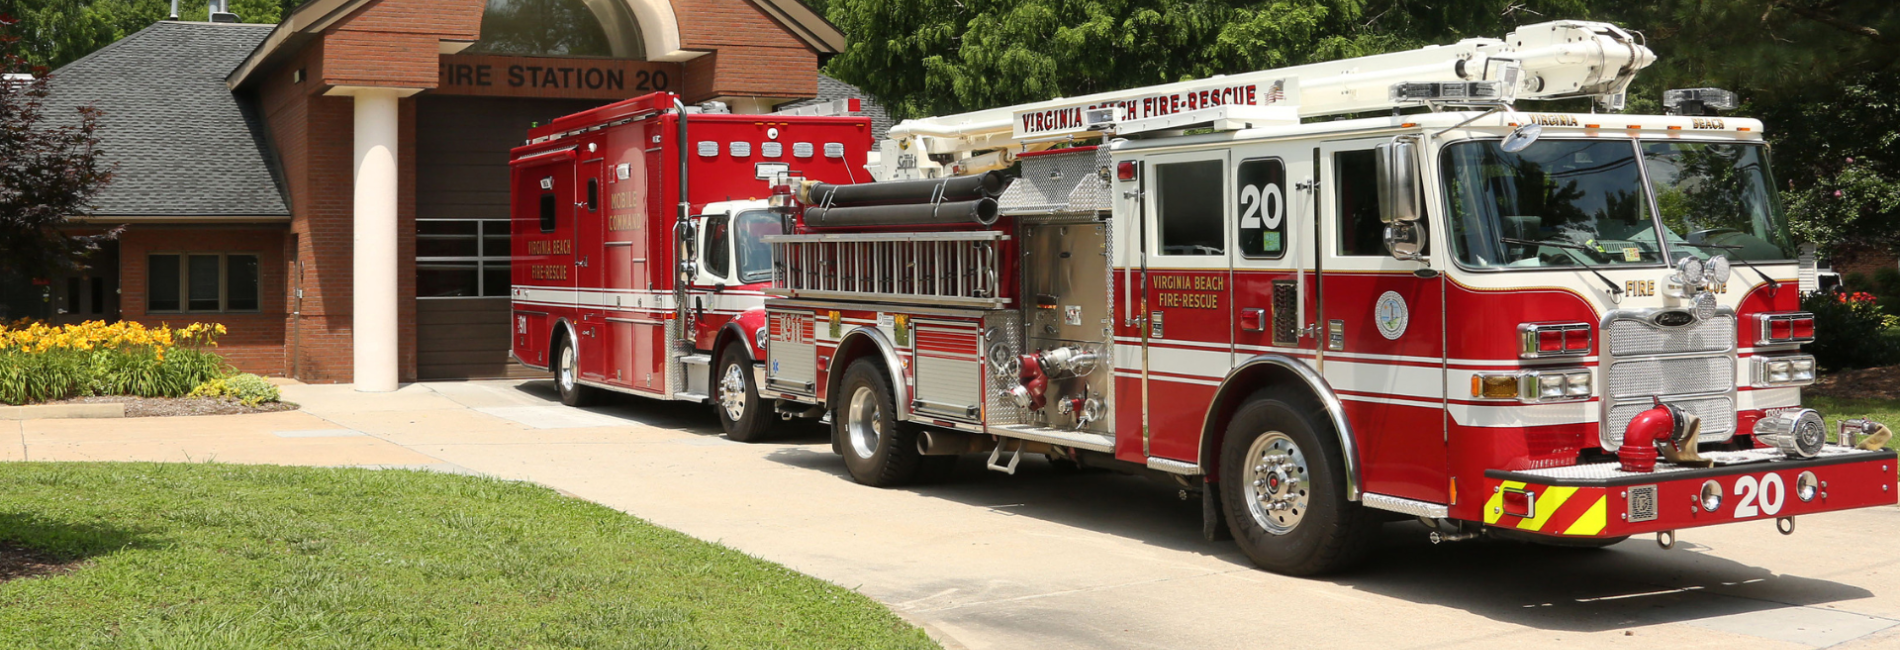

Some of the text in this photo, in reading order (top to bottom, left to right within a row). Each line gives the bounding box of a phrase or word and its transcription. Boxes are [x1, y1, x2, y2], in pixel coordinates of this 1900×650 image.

[507, 64, 624, 91] STATION
[635, 70, 668, 92] 20
[1022, 107, 1082, 133] VIRGINIA
[1142, 85, 1257, 118] FIRE-RESCUE
[1528, 113, 1579, 126] VIRGINIA
[1692, 117, 1725, 129] BEACH
[611, 191, 637, 210] MOBILE
[1240, 182, 1284, 230] 20
[608, 213, 641, 232] COMMAND
[528, 239, 571, 255] VIRGINIA BEACH
[531, 265, 567, 280] FIRE-RESCUE
[1153, 275, 1224, 291] VIRGINIA BEACH
[1625, 280, 1655, 297] FIRE
[1159, 292, 1218, 309] FIRE-RESCUE
[1734, 472, 1785, 518] 20
